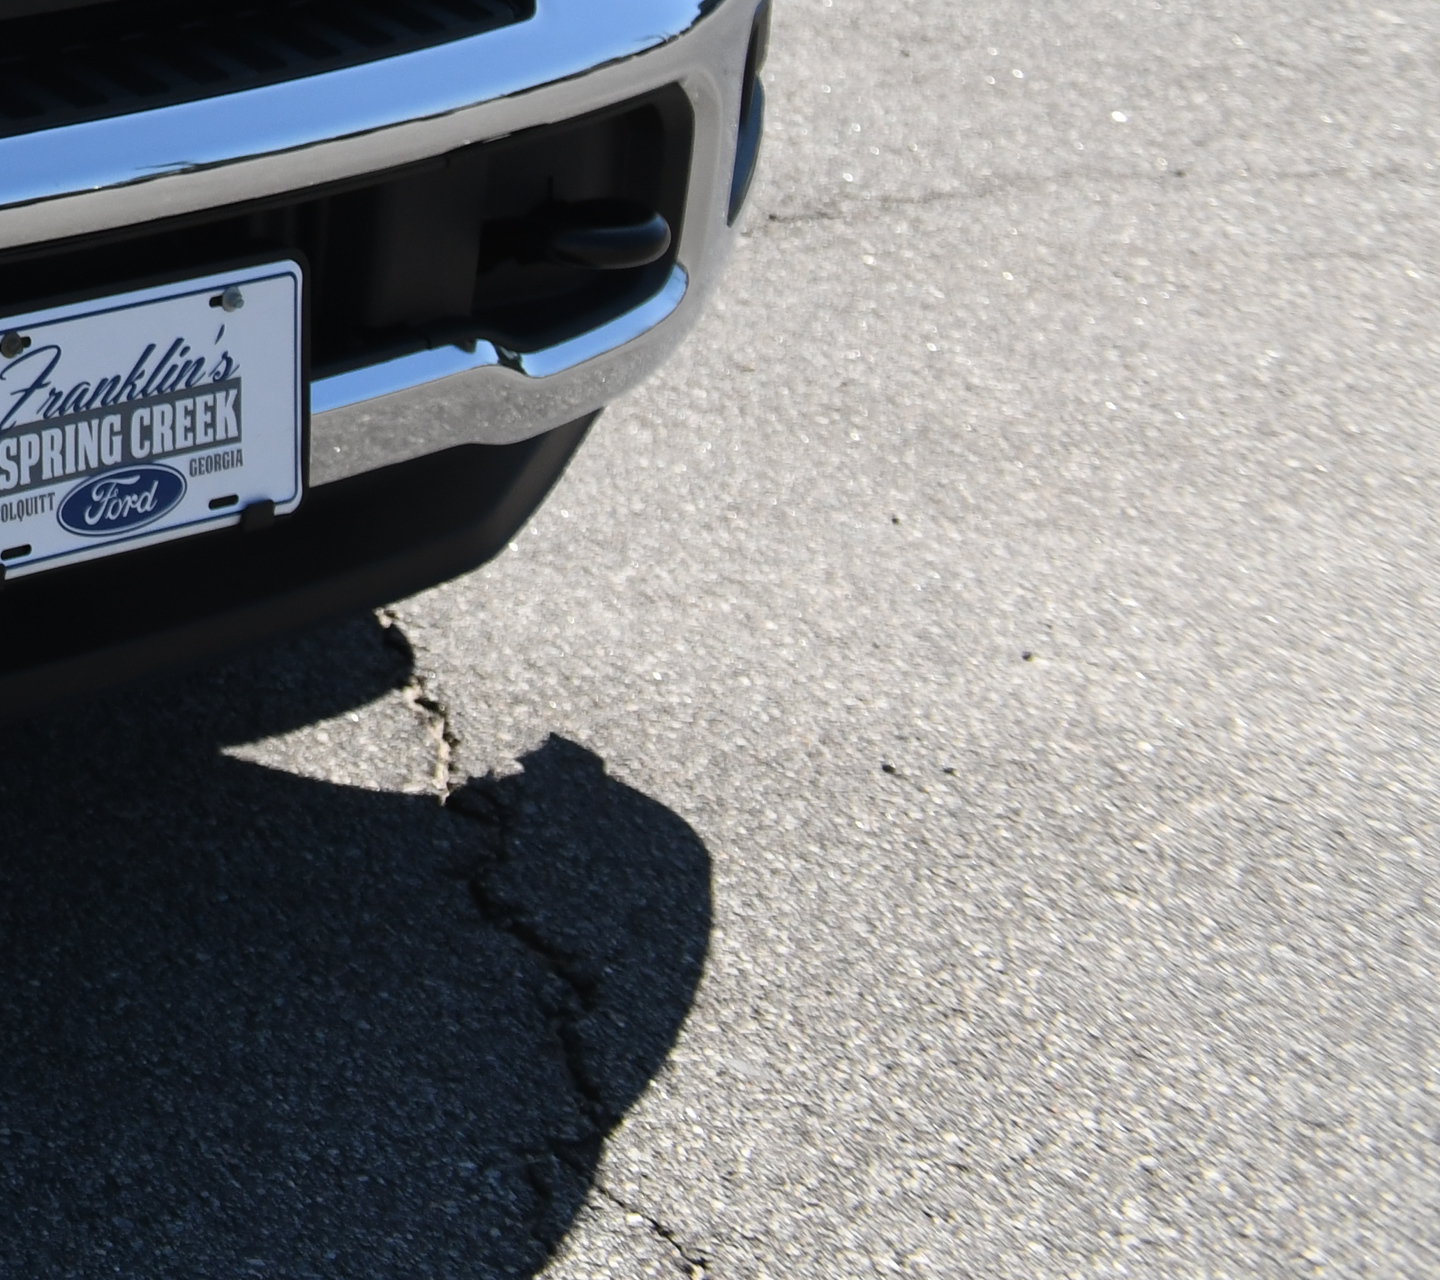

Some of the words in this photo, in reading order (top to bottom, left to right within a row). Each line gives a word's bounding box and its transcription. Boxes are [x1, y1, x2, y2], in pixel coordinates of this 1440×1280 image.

[131, 387, 240, 460] CREEK
[83, 474, 159, 527] Ford
[189, 448, 244, 478] GEORGIA
